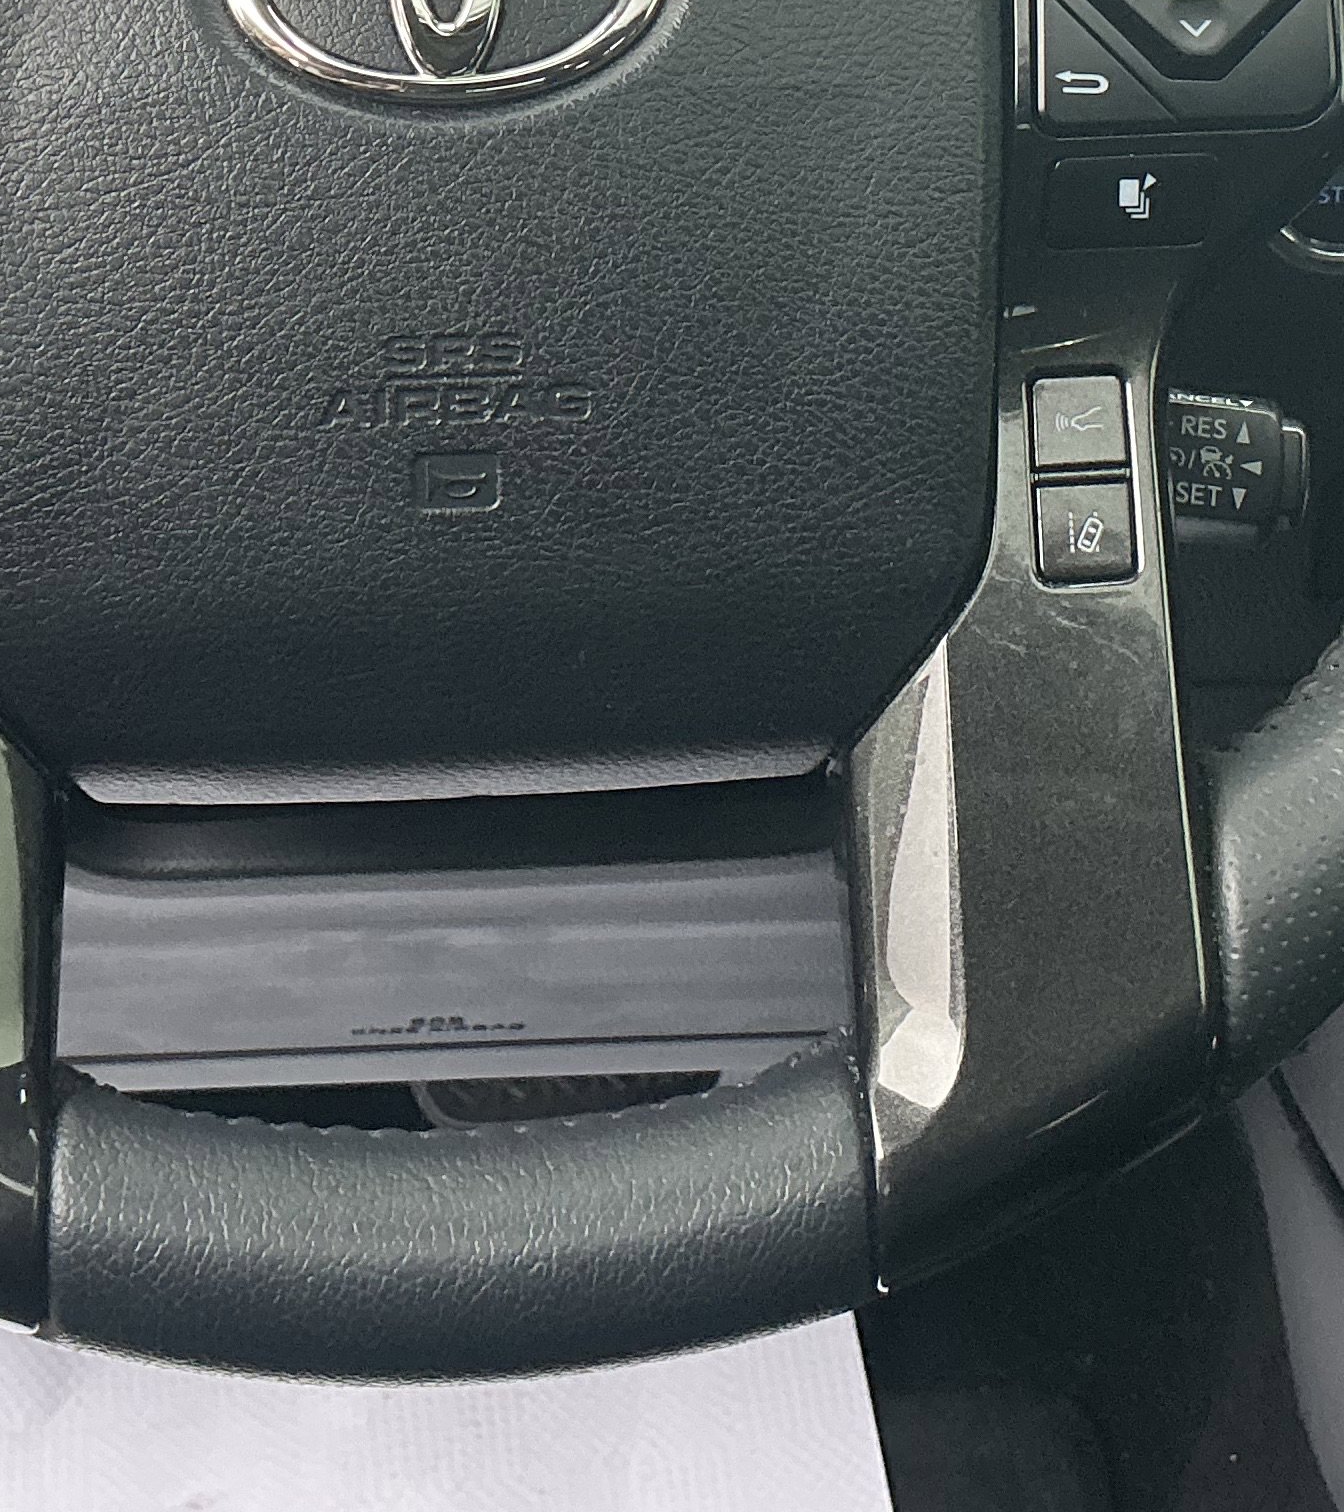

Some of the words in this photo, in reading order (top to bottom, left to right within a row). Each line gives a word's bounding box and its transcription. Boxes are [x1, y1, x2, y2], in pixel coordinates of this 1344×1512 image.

[383, 335, 525, 375] SRS
[318, 388, 594, 428] AIRBAG
[1180, 414, 1227, 440] RES
[1175, 481, 1224, 507] SET
